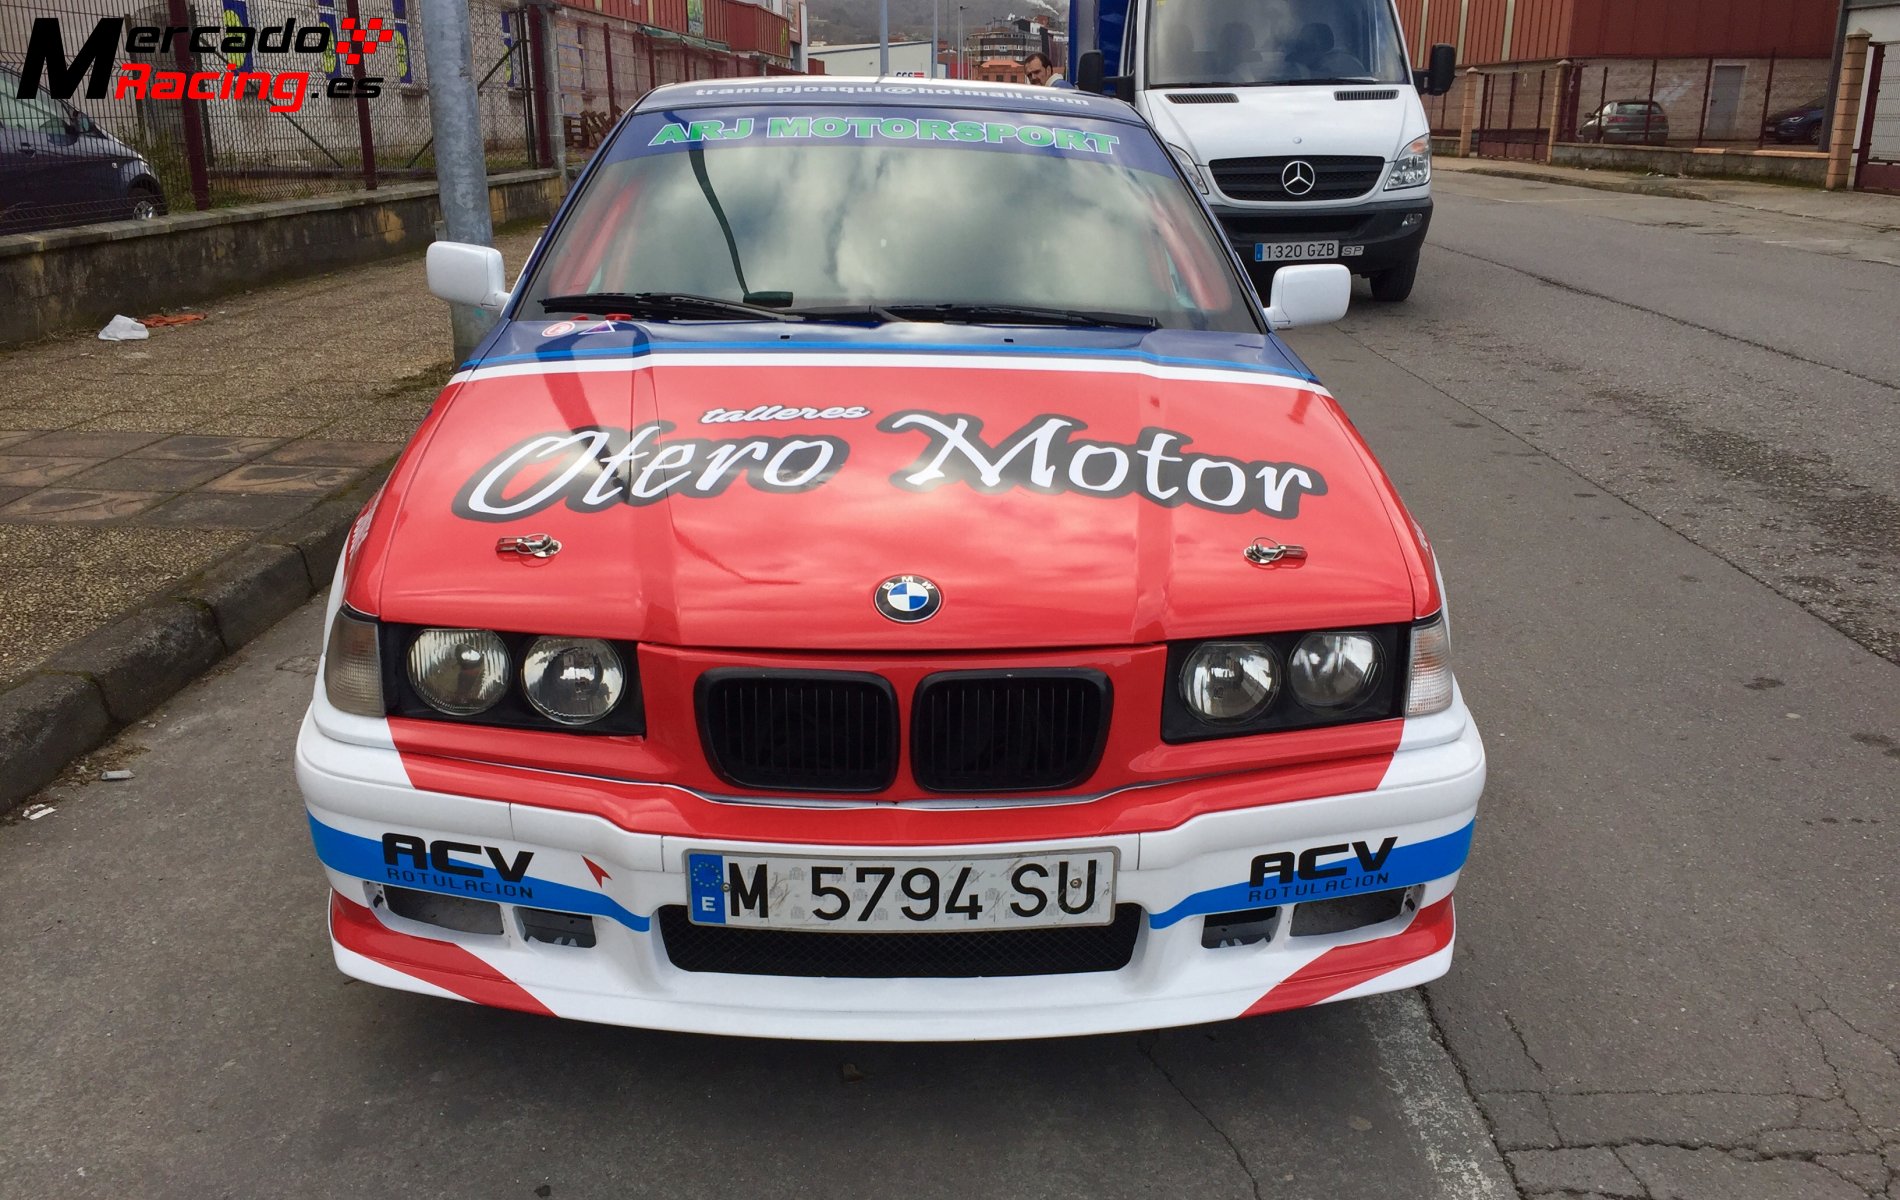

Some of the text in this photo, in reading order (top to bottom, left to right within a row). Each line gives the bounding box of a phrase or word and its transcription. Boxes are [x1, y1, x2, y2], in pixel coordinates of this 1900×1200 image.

[648, 117, 1120, 154] ARJ MOTORSPORT
[1266, 242, 1335, 259] 1320 GZB
[1343, 246, 1363, 256] SP
[700, 405, 871, 424] talleres
[466, 413, 1313, 515] Otero Motor
[881, 575, 935, 591] BMW
[382, 832, 535, 883] ACV
[1250, 836, 1398, 888] ACV
[386, 867, 534, 899] ROTULACION
[728, 859, 1098, 922] M 5794 SU
[1248, 872, 1389, 903] ROTULACION
[701, 896, 716, 912] E
